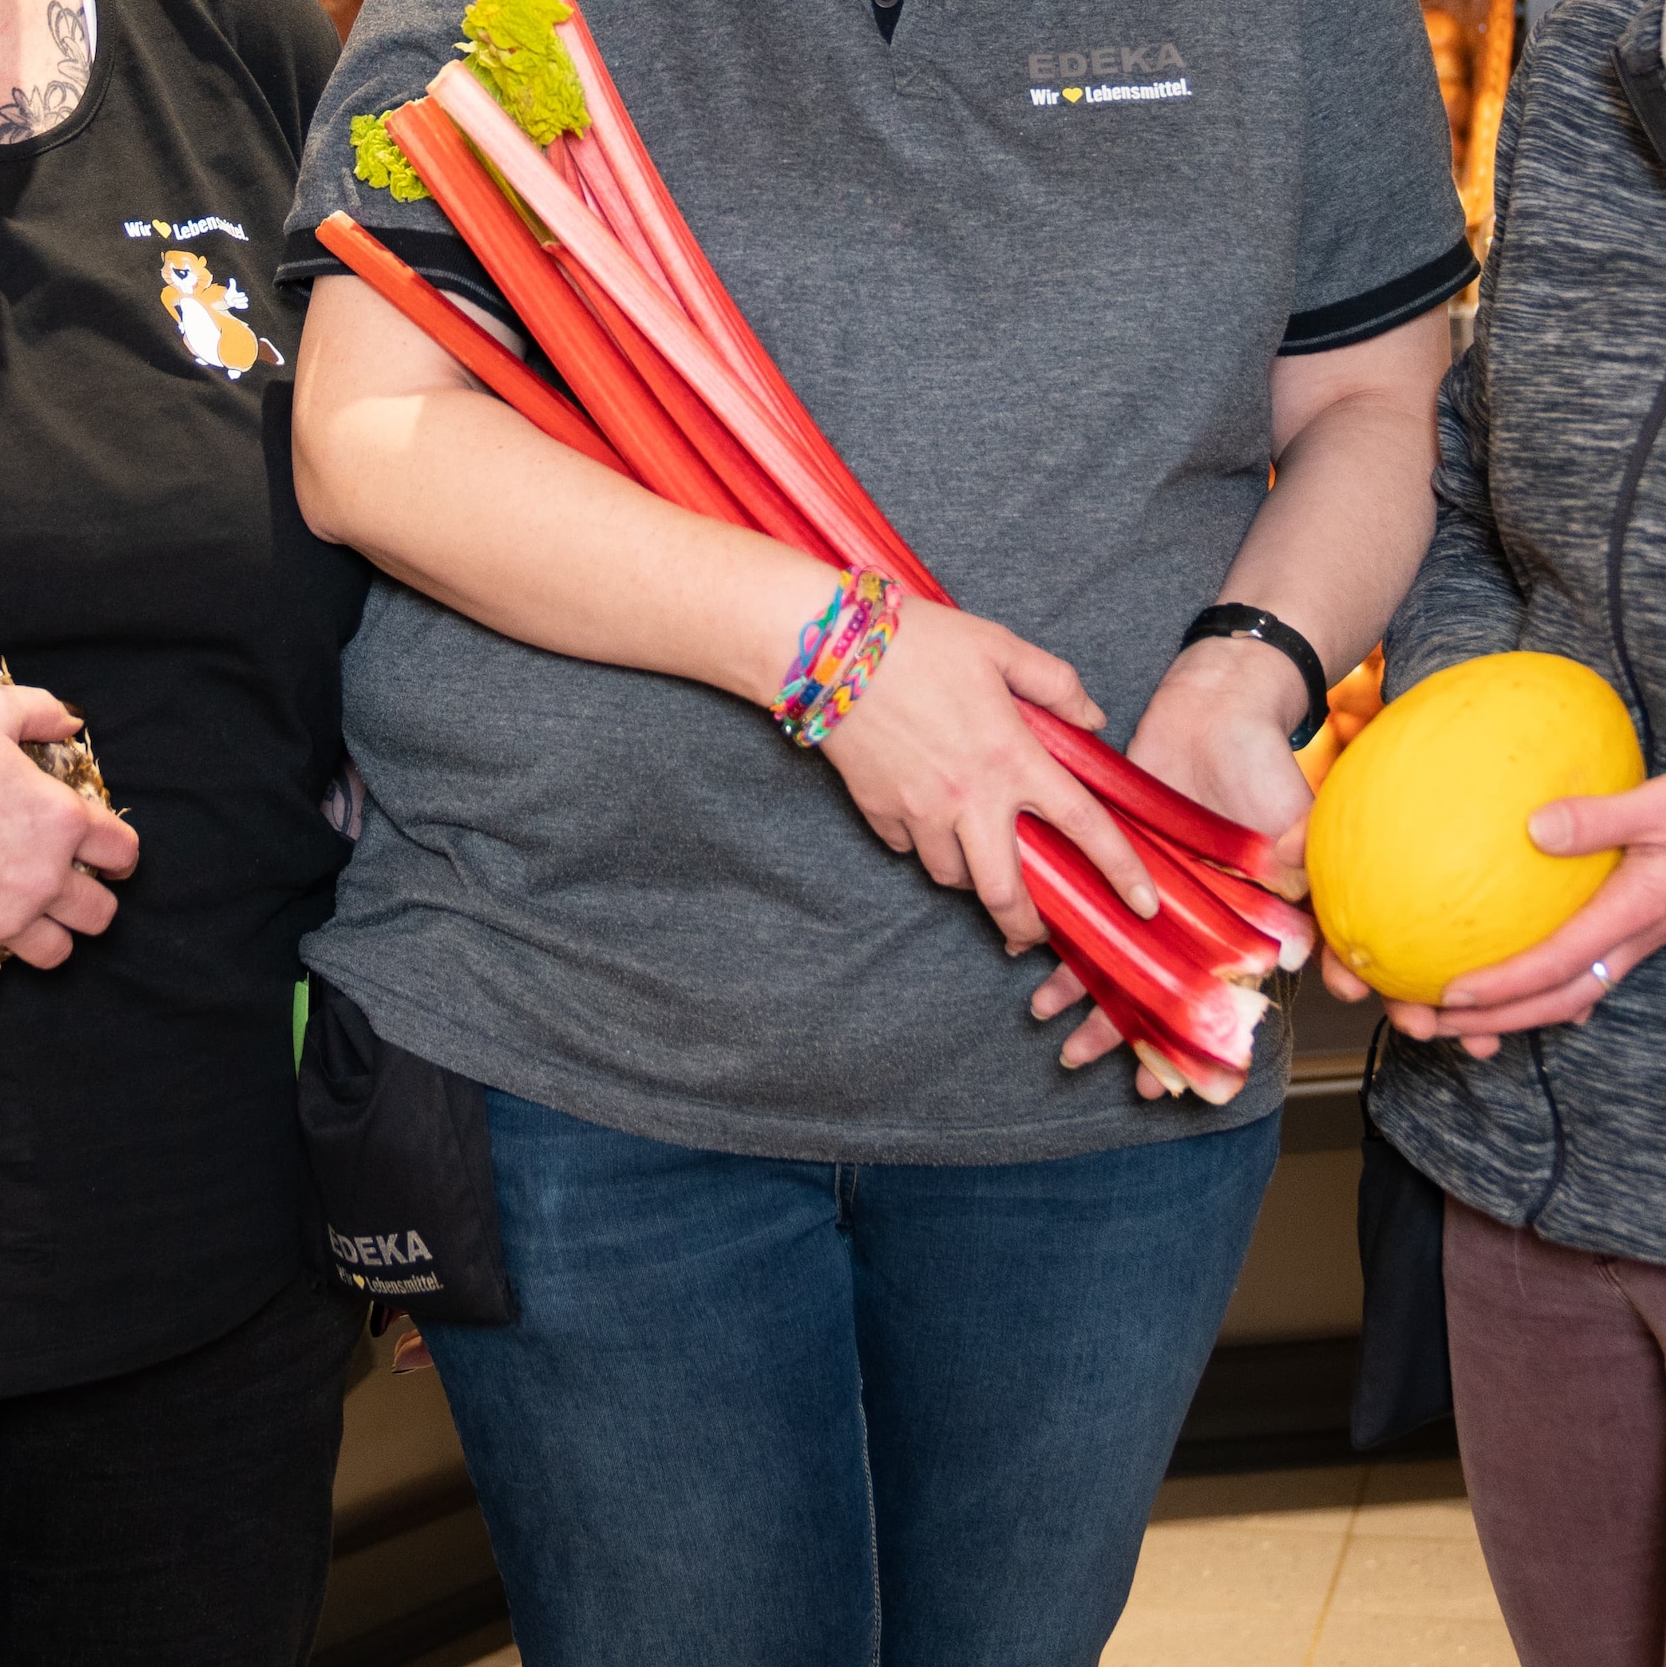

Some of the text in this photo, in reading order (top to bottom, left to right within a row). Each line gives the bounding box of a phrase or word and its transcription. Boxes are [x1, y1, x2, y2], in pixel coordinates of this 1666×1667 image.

[1028, 43, 1188, 80] EDEKA
[1030, 78, 1193, 106] Wir Lebensmittel.
[124, 220, 152, 238] Wir
[326, 1222, 433, 1266] EDEKA
[365, 1270, 444, 1294] Lebensmittel.
